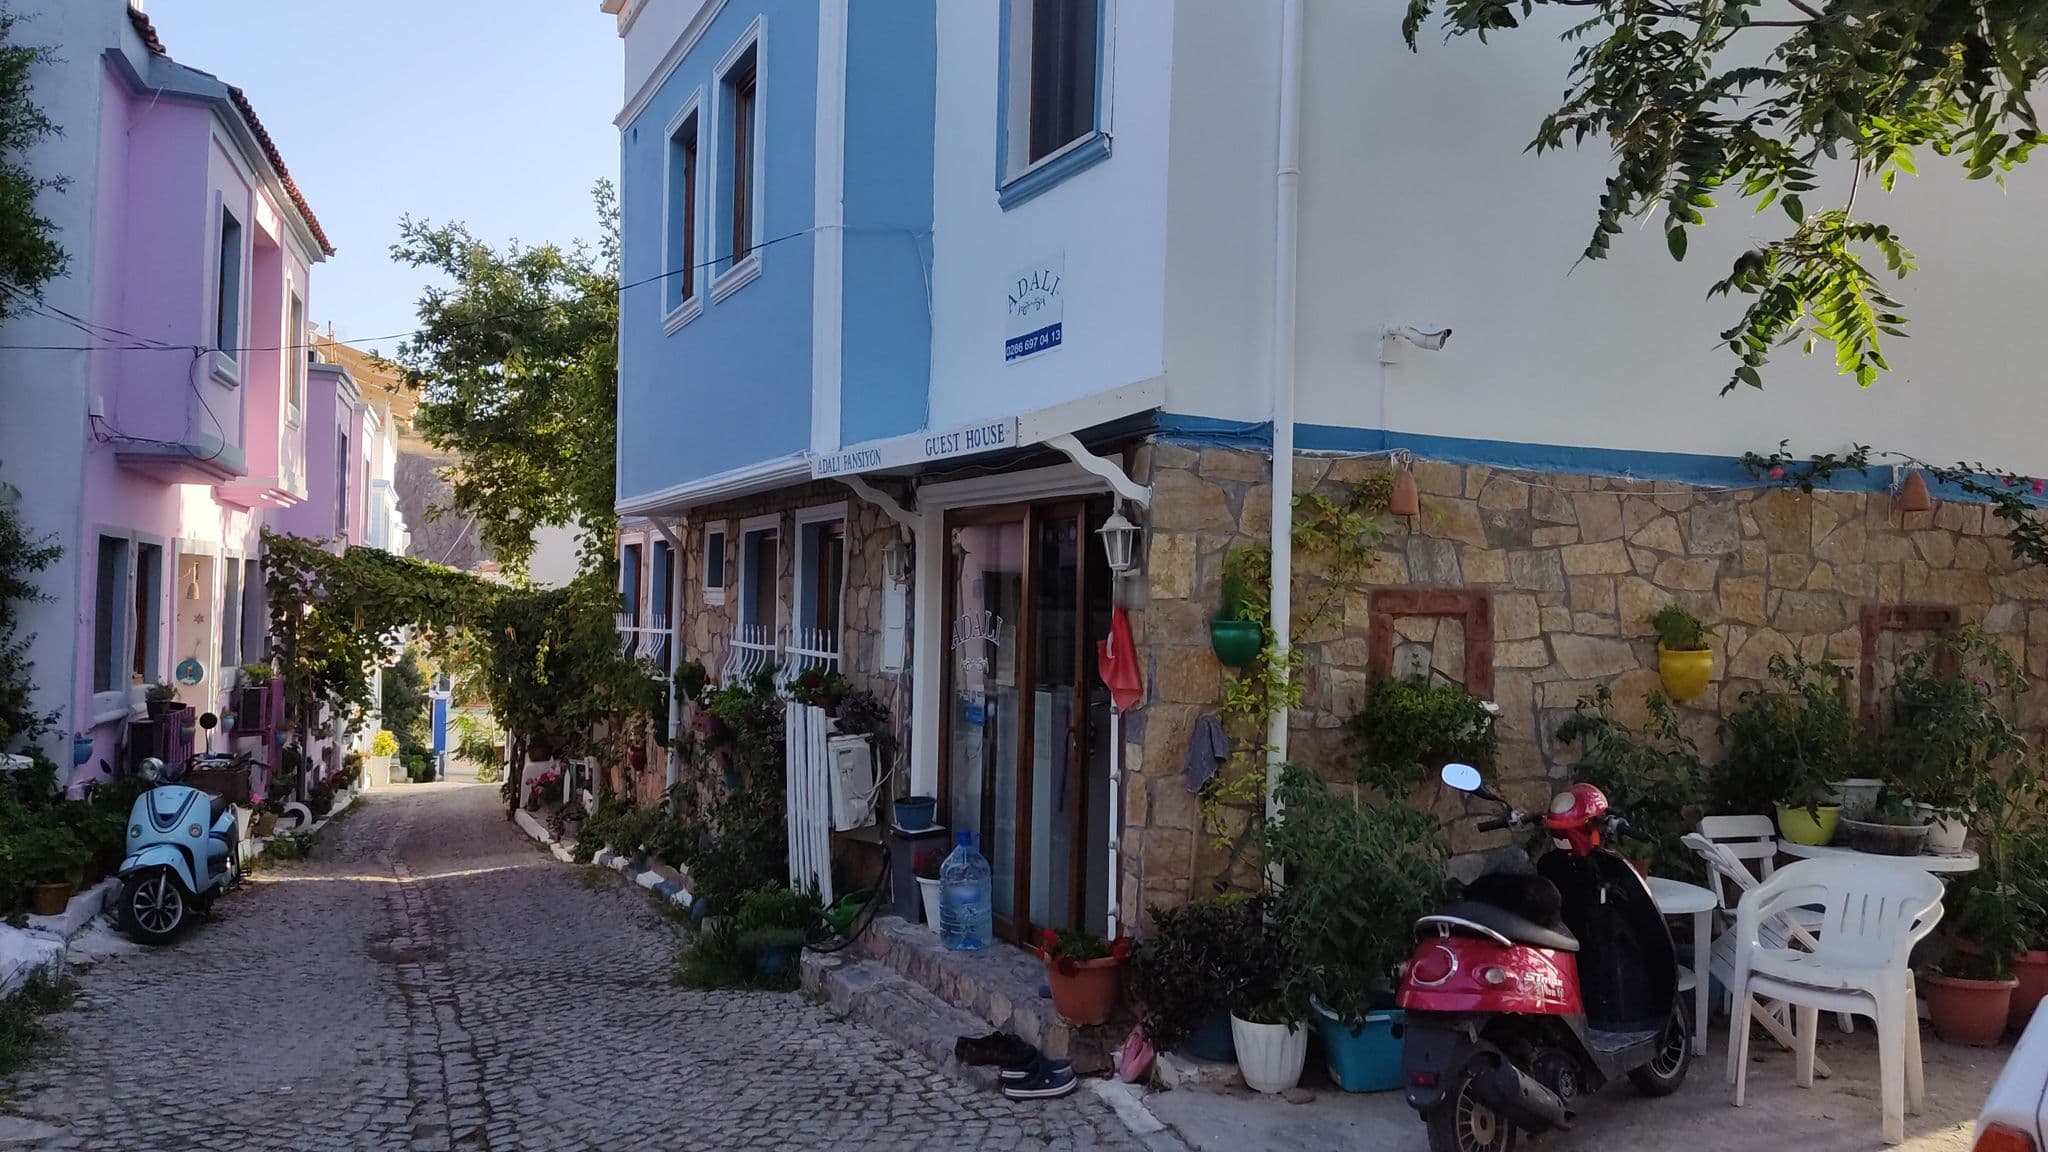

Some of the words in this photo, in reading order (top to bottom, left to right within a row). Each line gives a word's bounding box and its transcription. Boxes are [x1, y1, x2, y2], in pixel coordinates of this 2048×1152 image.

[1008, 270, 1061, 314] ADALI
[1006, 343, 1024, 357] 0286
[1024, 337, 1039, 352] 697
[1039, 331, 1049, 346] 04
[1051, 328, 1061, 343] 13
[925, 432, 961, 457] GUEST
[965, 423, 1005, 449] HOUSE
[817, 456, 841, 474] ADALI
[950, 609, 1004, 650] ADALI
